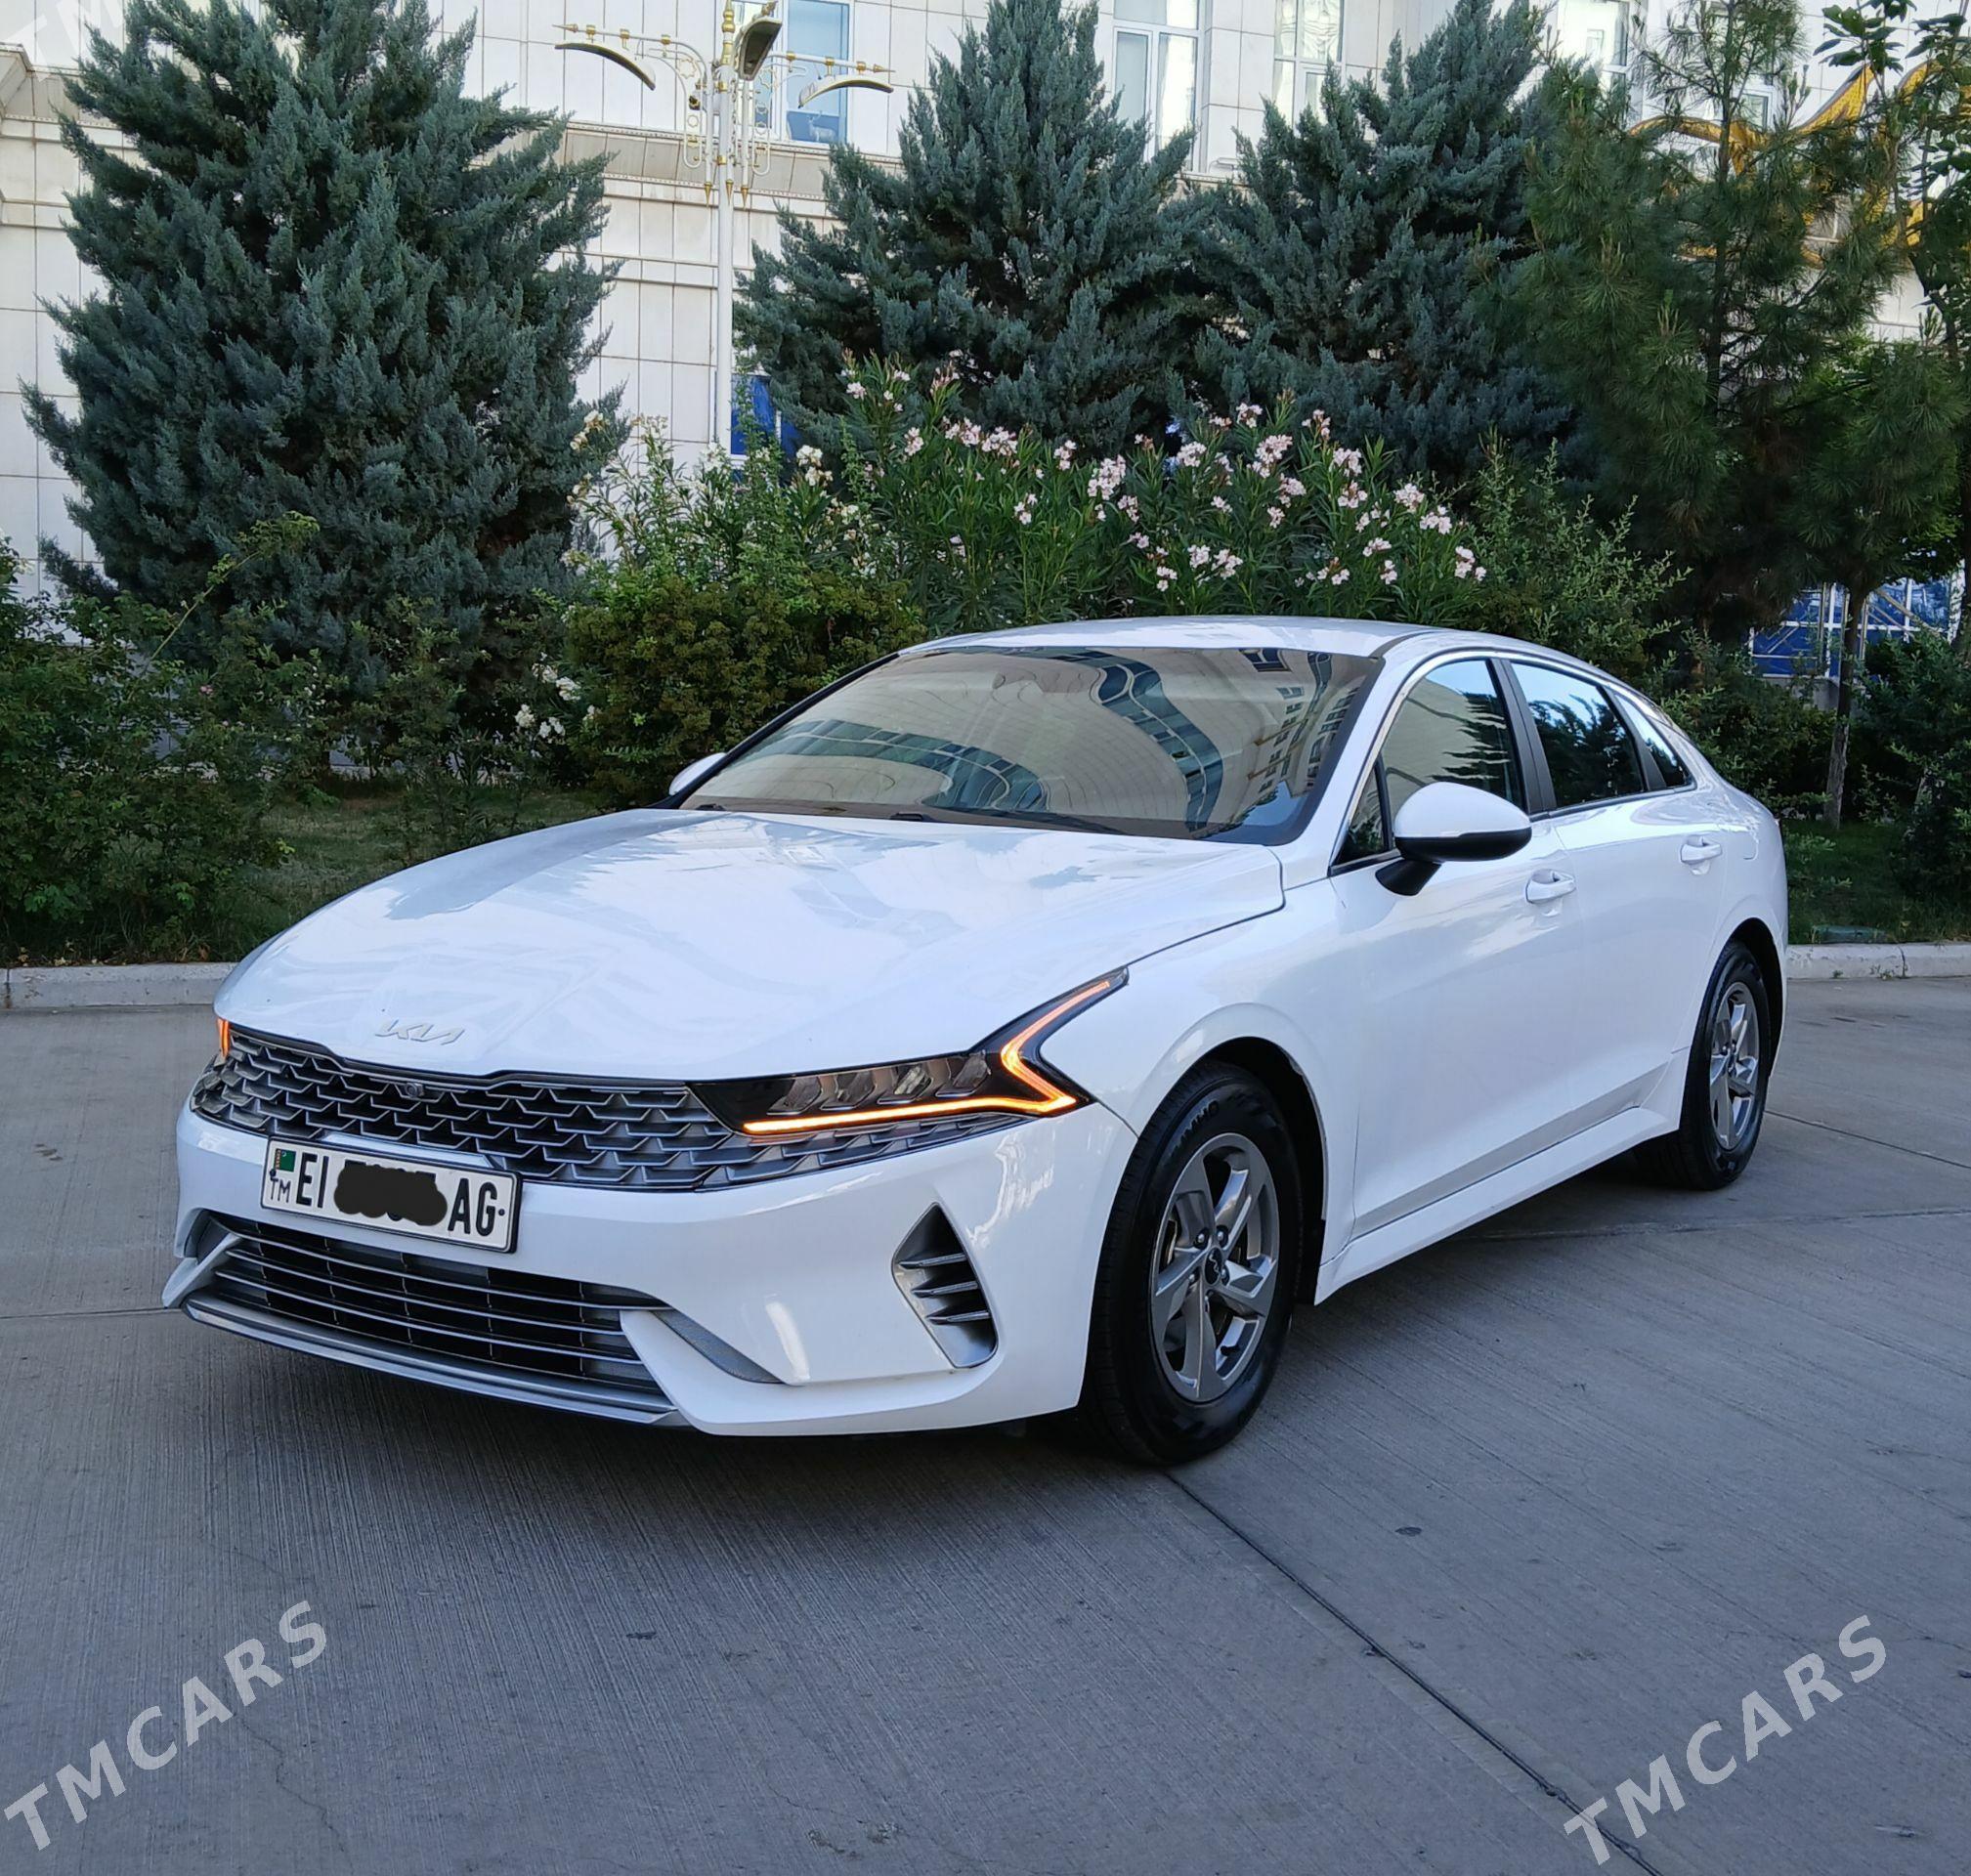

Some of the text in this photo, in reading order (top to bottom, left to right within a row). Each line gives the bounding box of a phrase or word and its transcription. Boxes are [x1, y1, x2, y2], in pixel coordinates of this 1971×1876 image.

[375, 1019, 465, 1045] KIA
[270, 1176, 291, 1203] TM
[448, 1178, 497, 1237] AG
